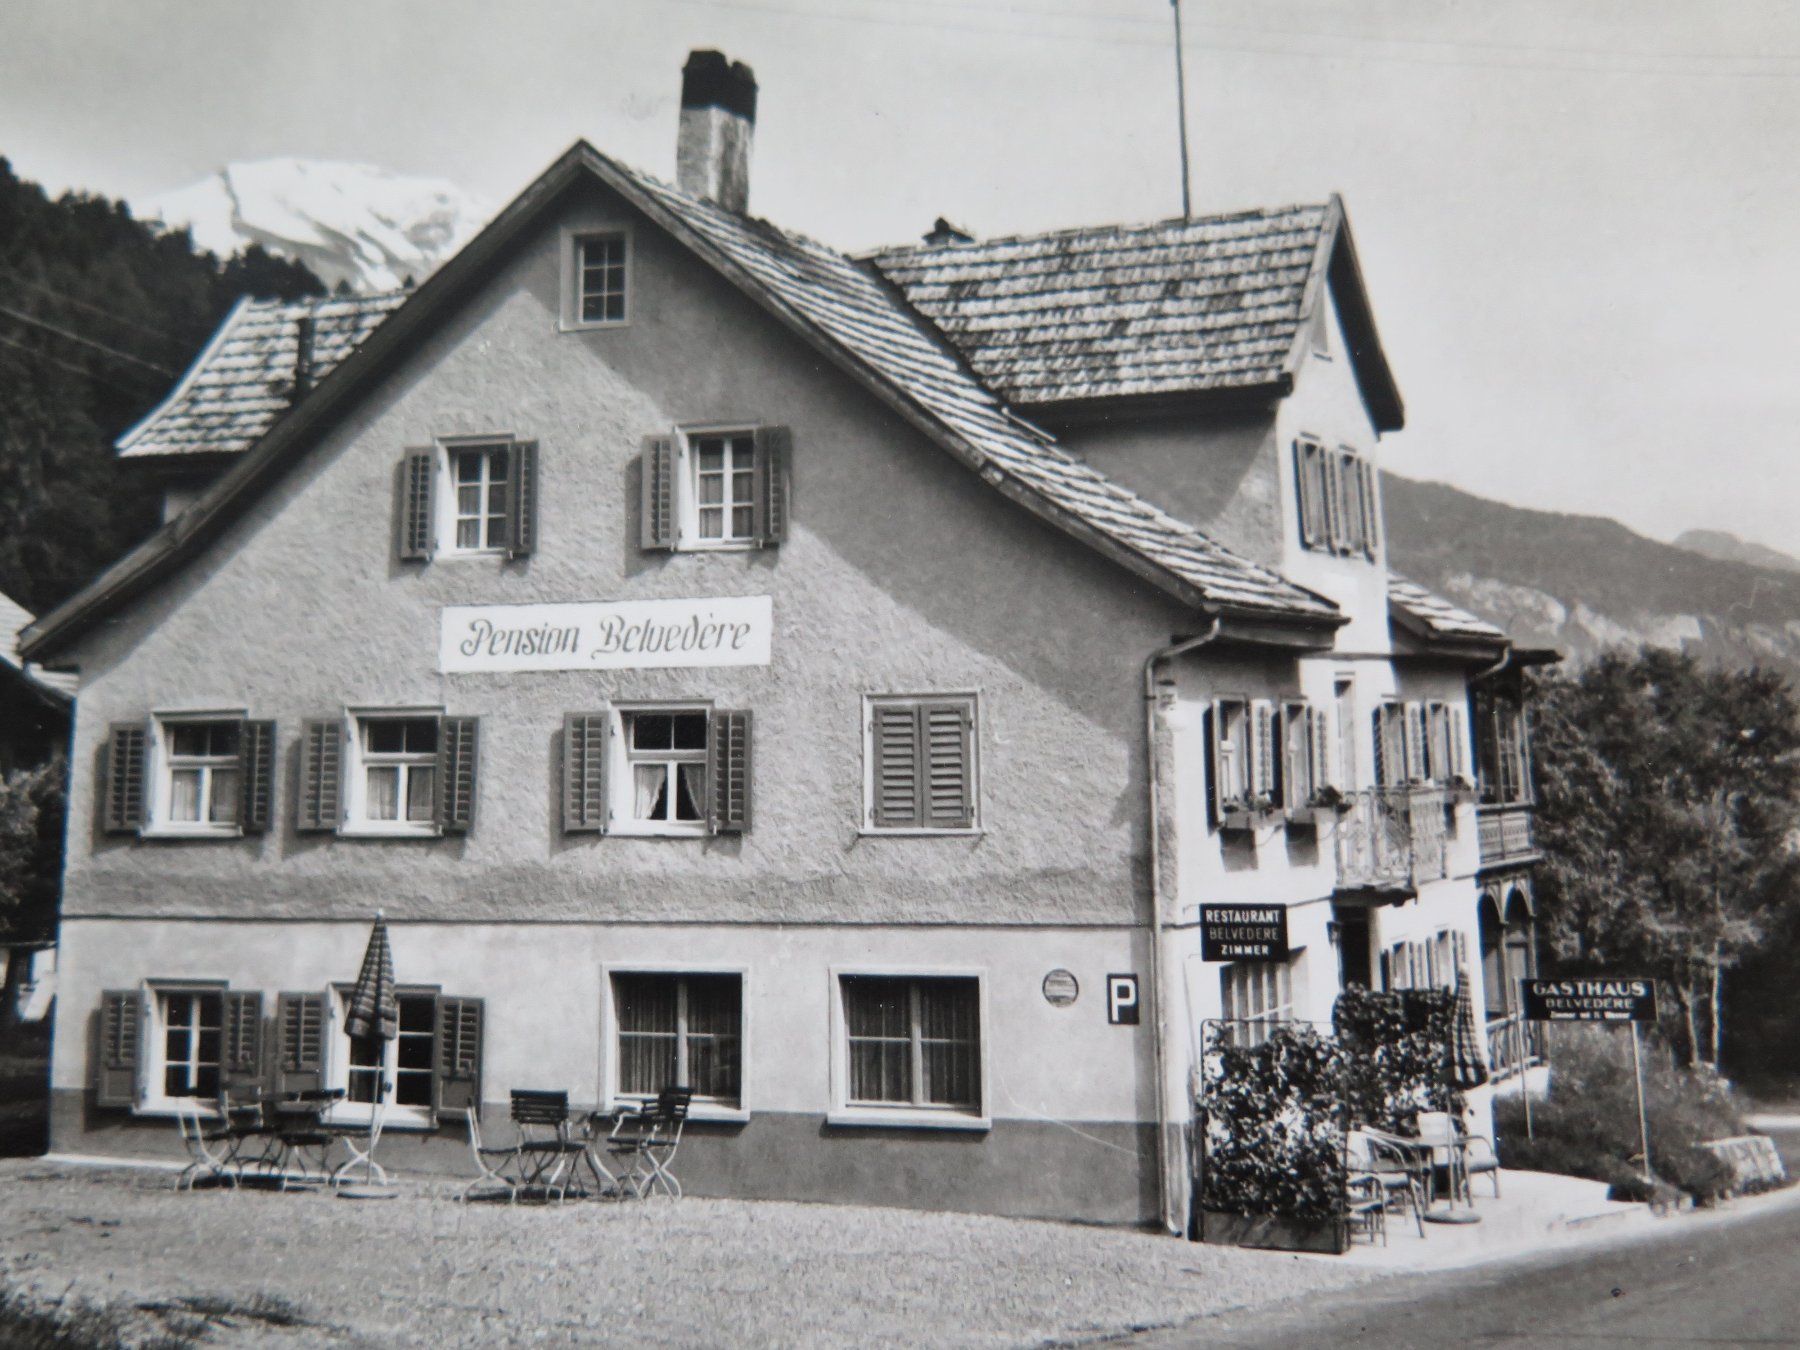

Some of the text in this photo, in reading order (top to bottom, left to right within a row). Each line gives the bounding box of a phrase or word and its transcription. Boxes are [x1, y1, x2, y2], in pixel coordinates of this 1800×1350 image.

[460, 612, 751, 660] Pension Belvedère
[1205, 909, 1280, 923] RESTAURANT
[1220, 944, 1269, 956] ZIMMER
[1532, 981, 1647, 997] GASTHAUS
[1110, 978, 1136, 1022] P
